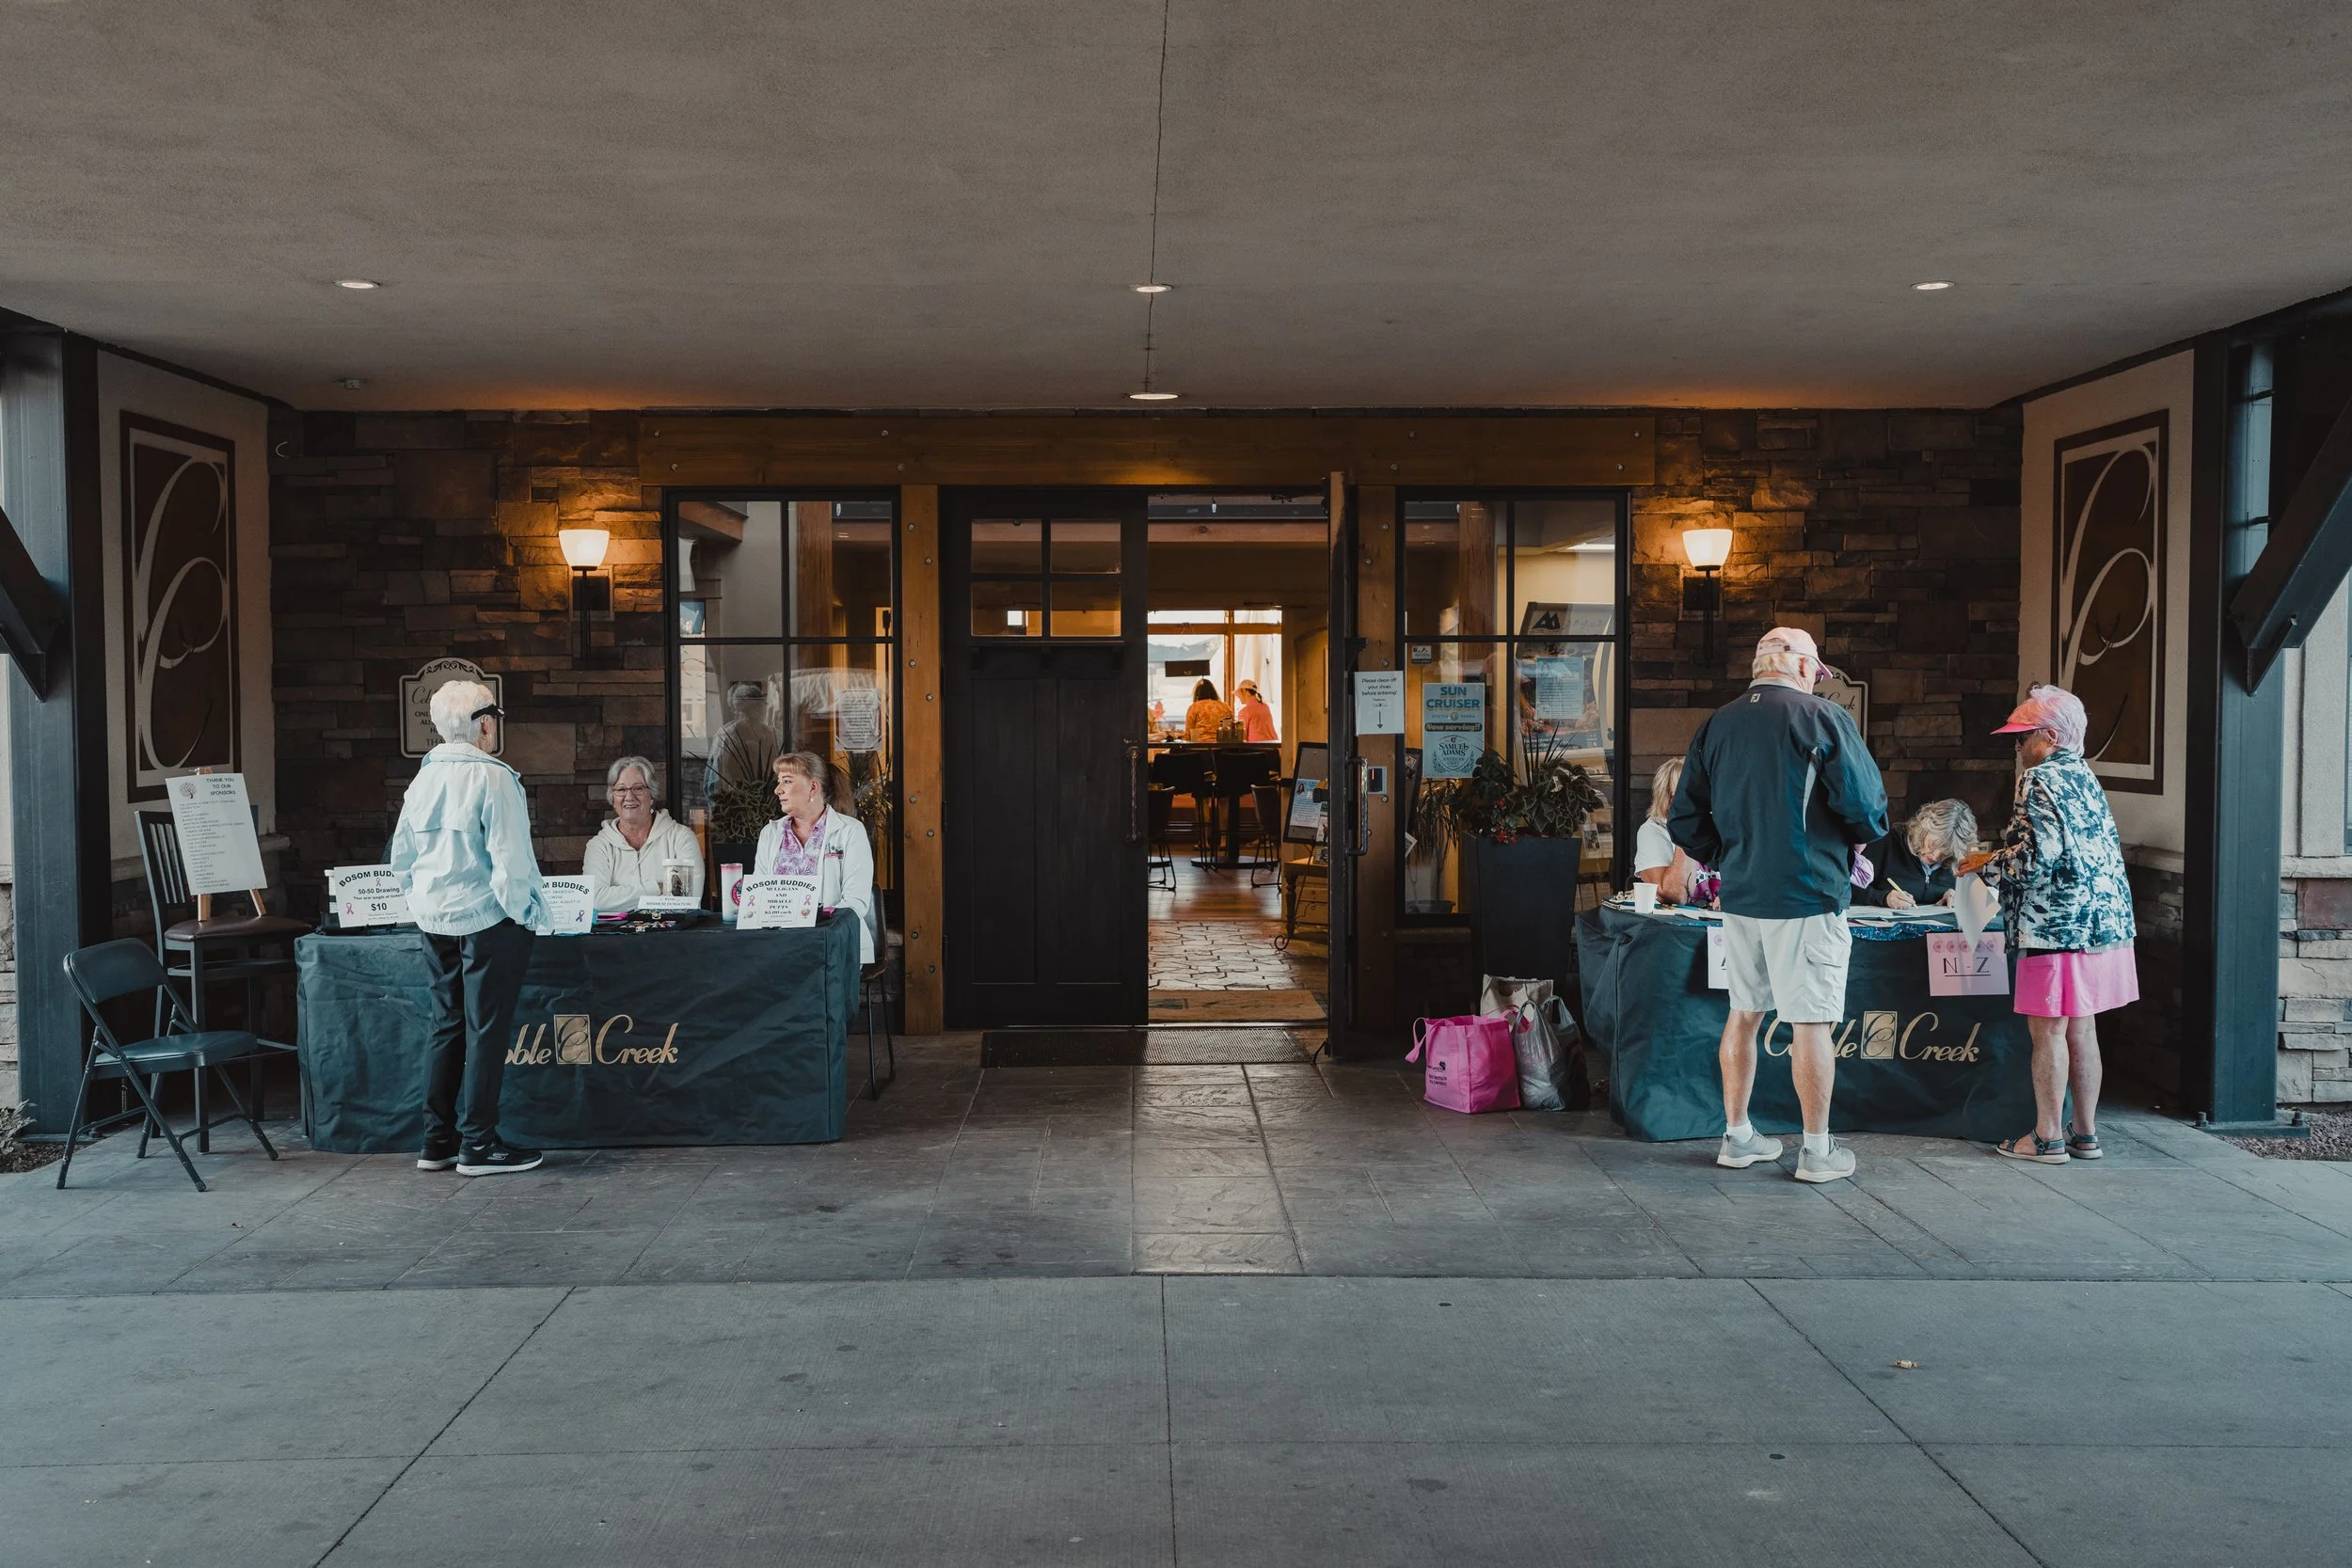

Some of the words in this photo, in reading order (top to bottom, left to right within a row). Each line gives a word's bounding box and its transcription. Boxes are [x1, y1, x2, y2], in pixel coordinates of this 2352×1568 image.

[1440, 686, 1467, 696] SUN
[1426, 698, 1481, 708] CRUISER
[339, 871, 371, 887] BOSOM
[746, 880, 778, 892] BOSOM
[780, 879, 816, 892] BUDDIES
[552, 882, 590, 895] BUDDIES
[371, 903, 387, 911] $10
[1943, 958, 1958, 974] N
[1976, 957, 1989, 973] Z
[595, 1014, 679, 1065] Creek
[1899, 1012, 1982, 1062] Creek
